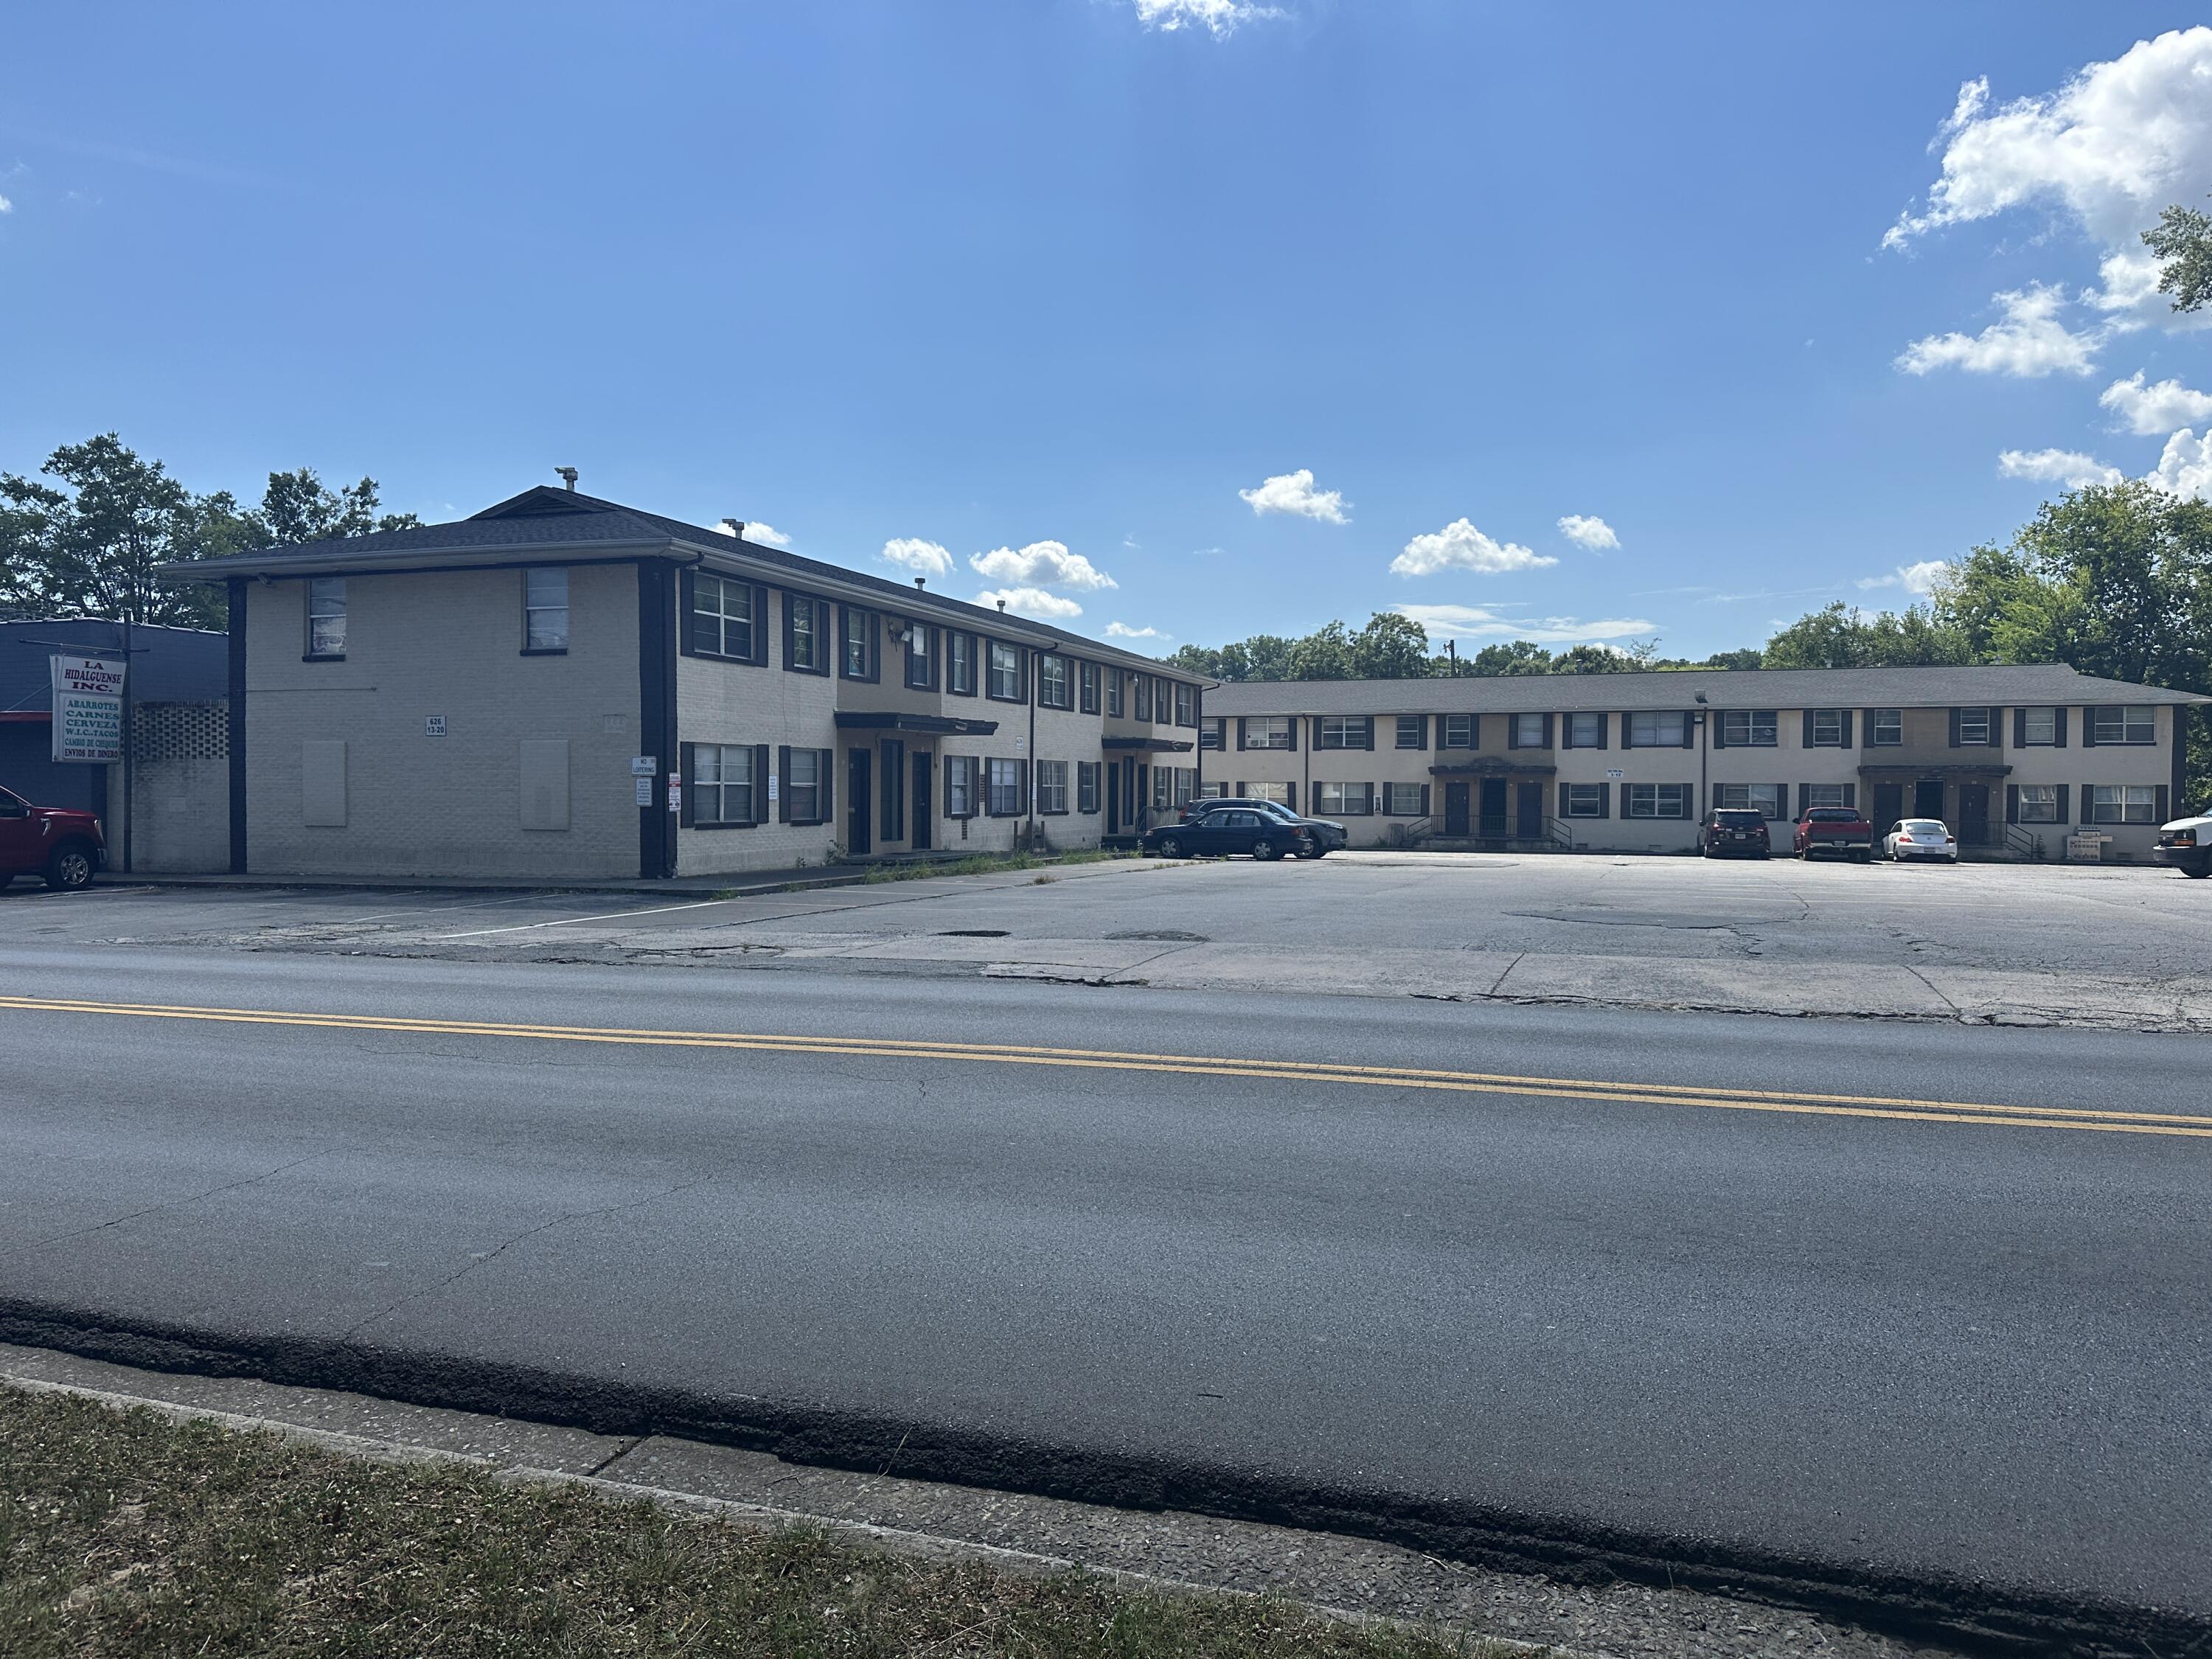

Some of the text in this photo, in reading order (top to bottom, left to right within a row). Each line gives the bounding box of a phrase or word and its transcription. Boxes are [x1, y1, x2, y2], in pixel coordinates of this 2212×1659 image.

[84, 661, 104, 670] LA
[64, 669, 122, 684] HIDALGUENSE
[72, 681, 113, 692] INC.
[67, 700, 119, 711] ABARROTES
[66, 711, 119, 720] CARNES
[66, 719, 118, 728] CERVEZA
[64, 748, 86, 757] ENVIOS
[98, 750, 119, 759] DINERO
